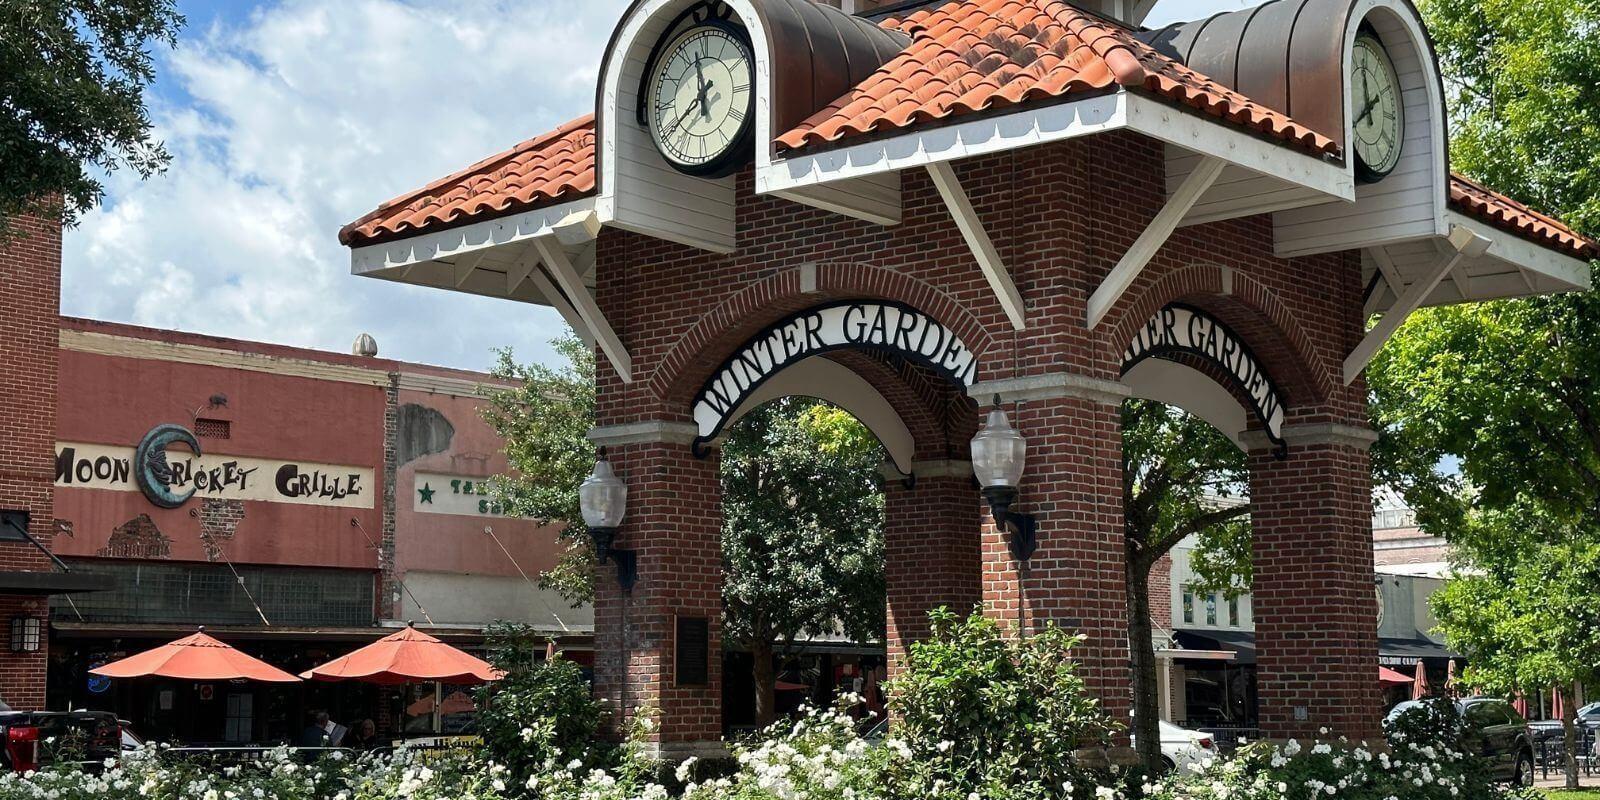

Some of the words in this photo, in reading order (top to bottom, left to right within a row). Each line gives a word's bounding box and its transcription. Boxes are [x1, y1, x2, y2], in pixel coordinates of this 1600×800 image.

[702, 309, 830, 417] WINTER
[1188, 312, 1279, 420] GARDEN
[54, 446, 130, 484] MOON
[275, 464, 363, 501] GRILLE
